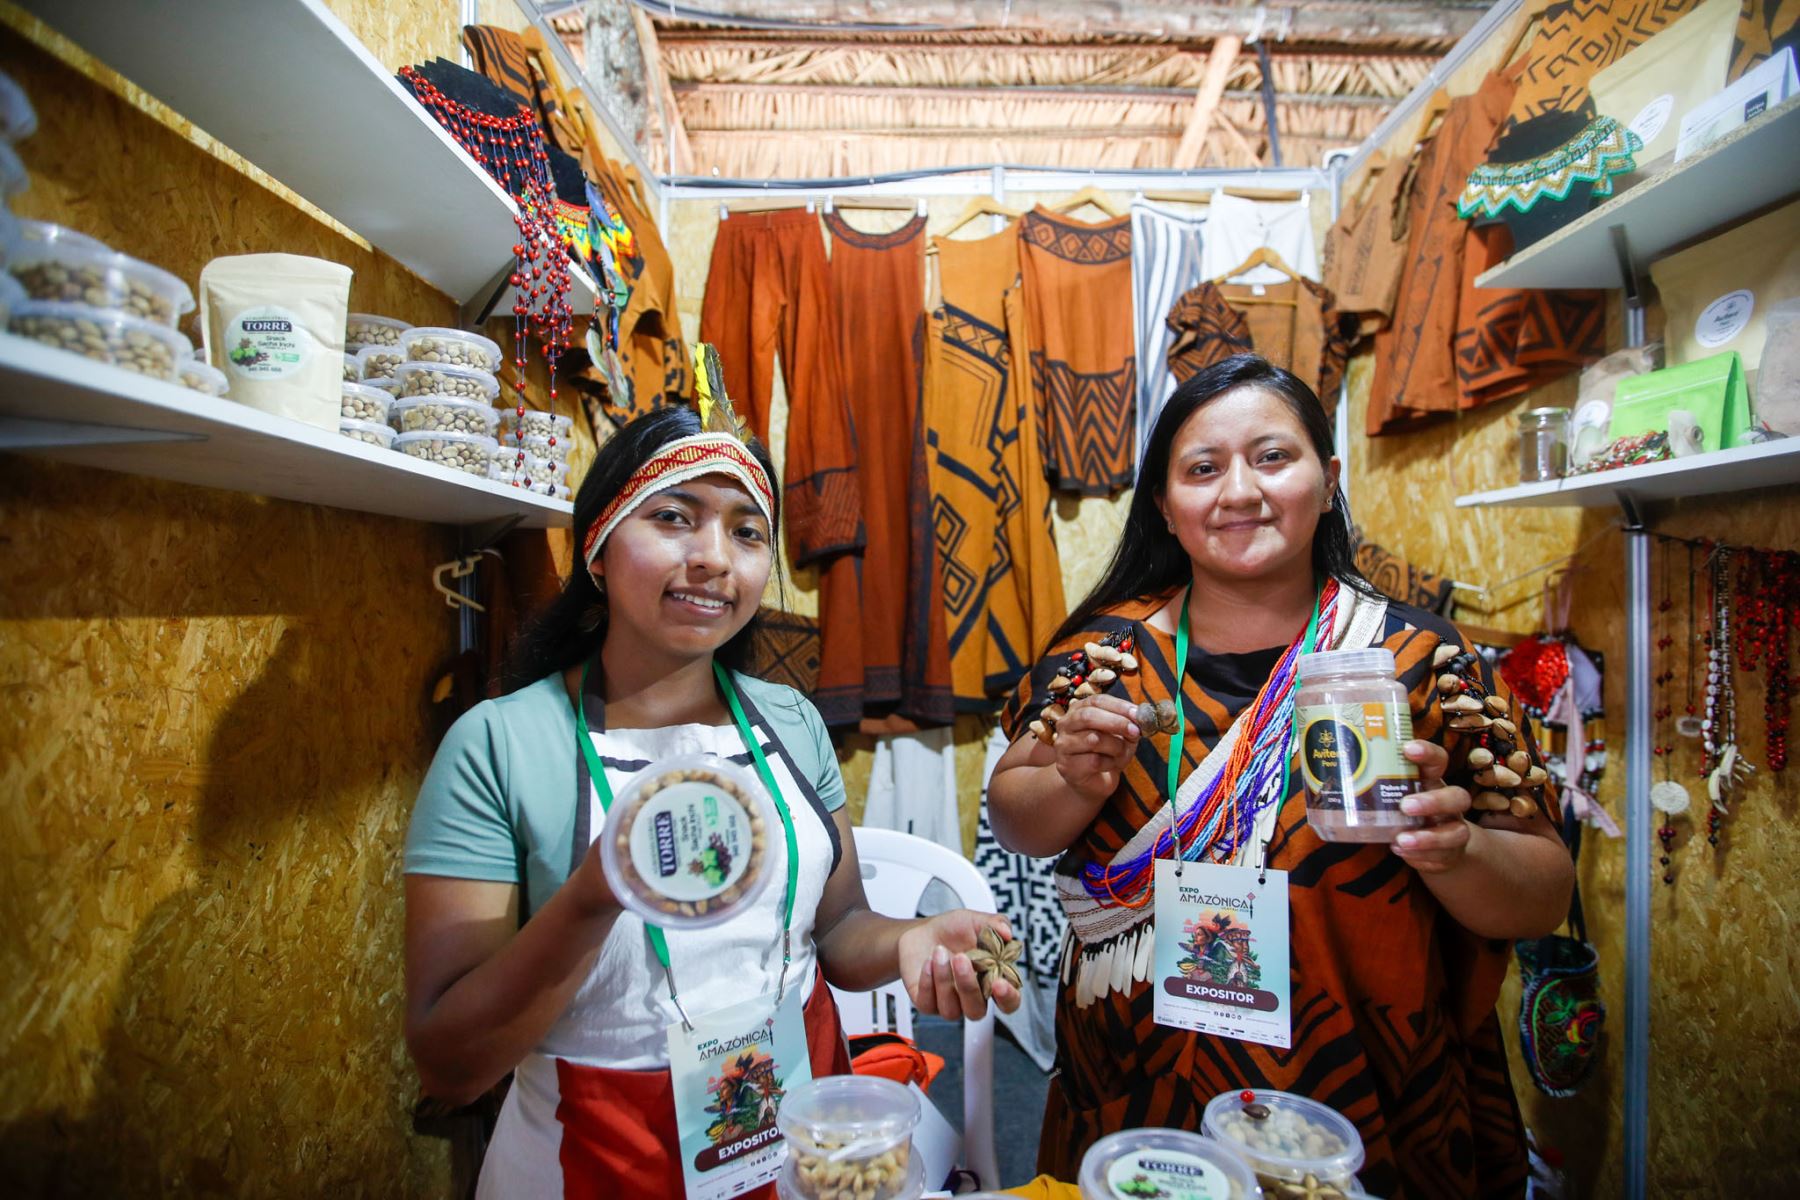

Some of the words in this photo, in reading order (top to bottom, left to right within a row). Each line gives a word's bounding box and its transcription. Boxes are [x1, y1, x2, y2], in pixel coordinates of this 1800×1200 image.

[244, 321, 290, 331] TORRE
[656, 813, 676, 874] TORRE
[1179, 886, 1199, 894] EXPO
[1180, 893, 1249, 909] AMAZÓNICA
[1186, 984, 1255, 1004] EXPOSITOR
[698, 1038, 719, 1051] EXPO
[699, 1029, 769, 1062] AMAZÓNICA
[718, 1126, 783, 1160] EXPOSITO
